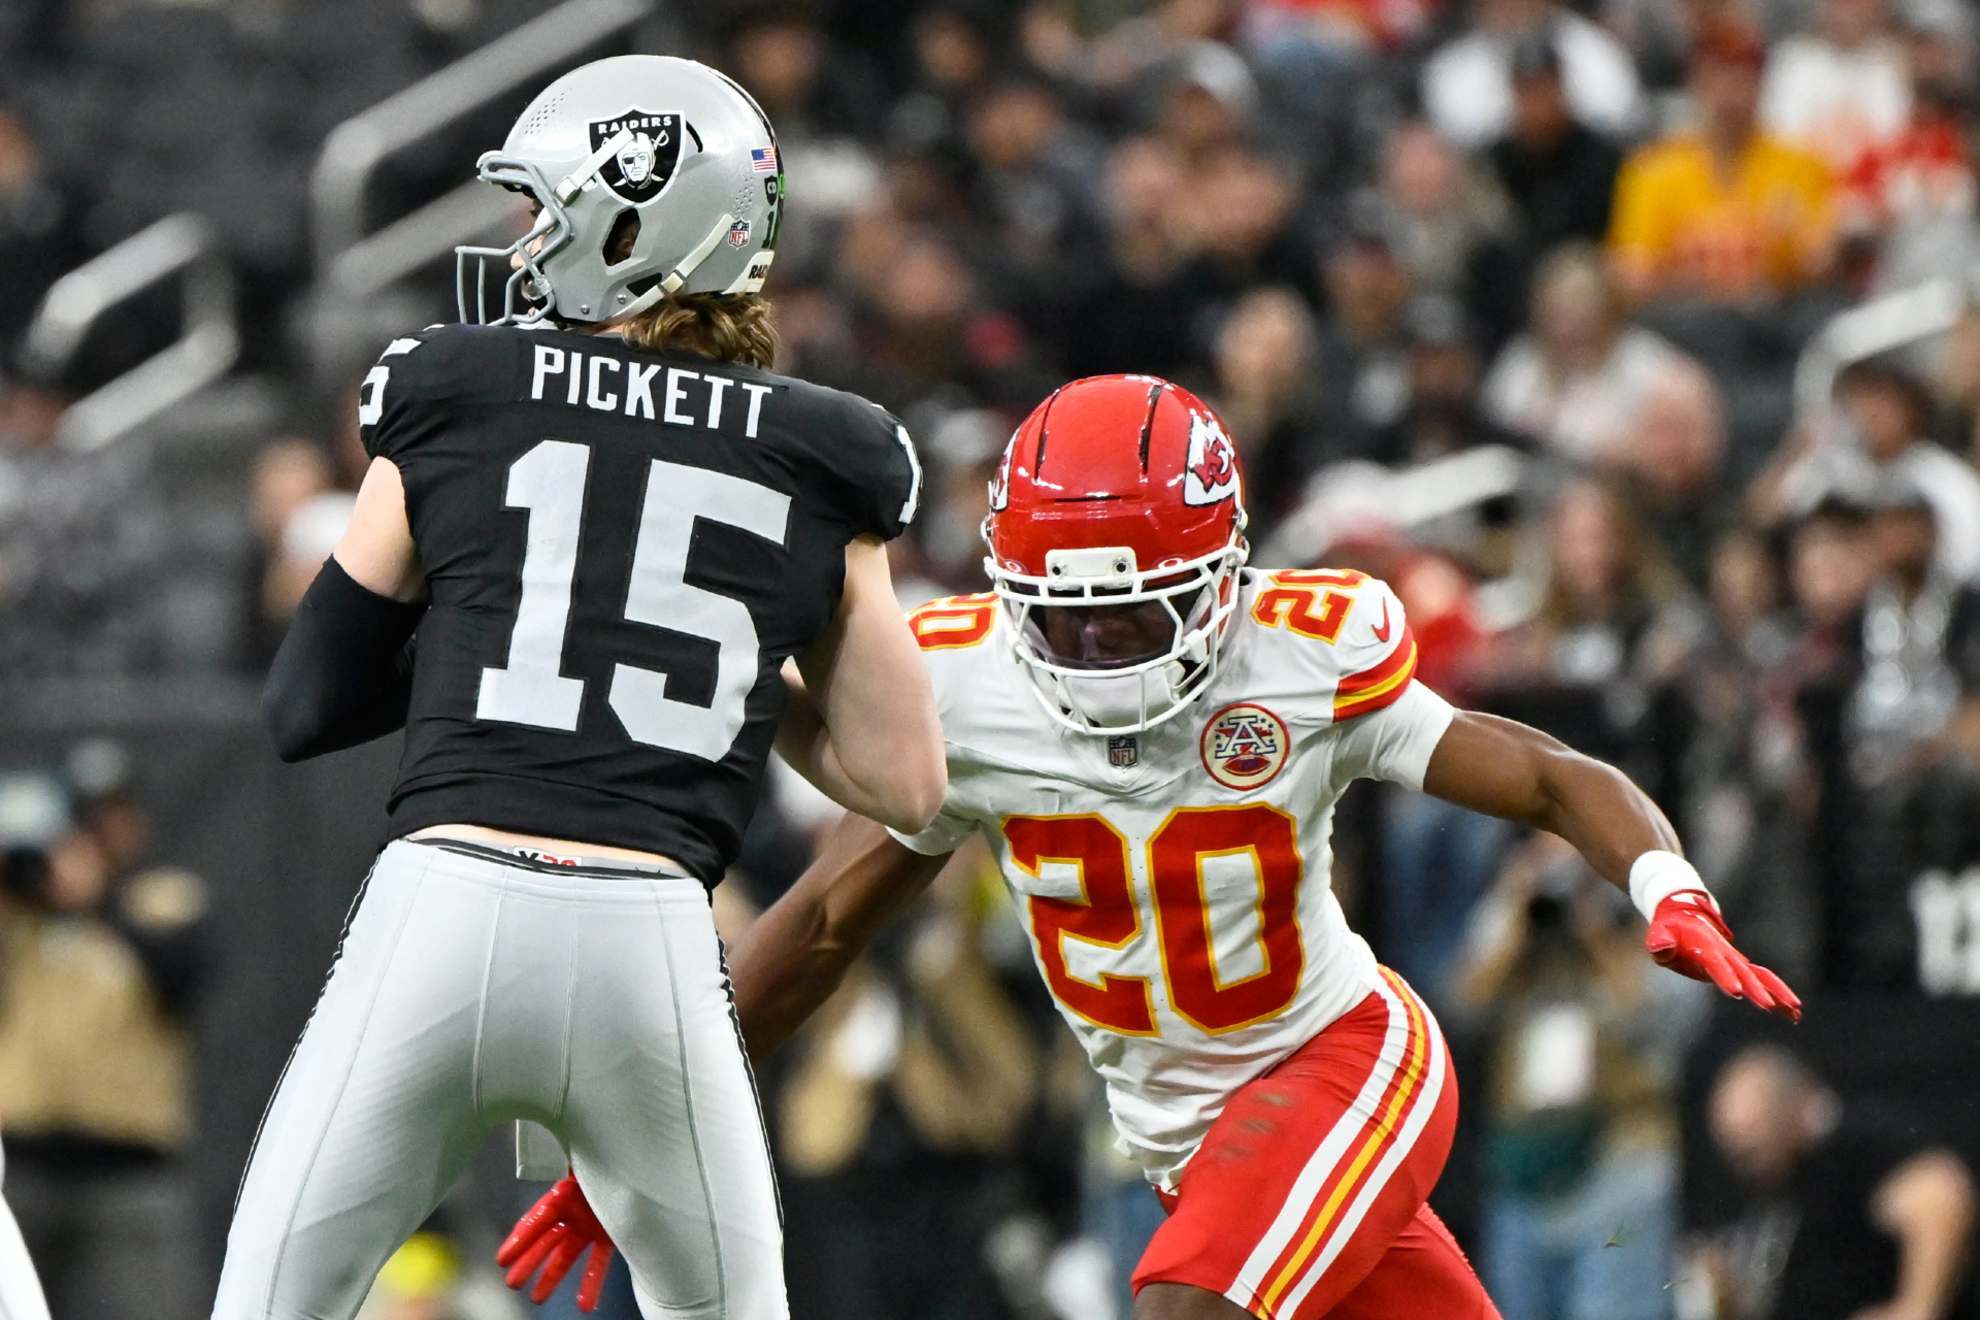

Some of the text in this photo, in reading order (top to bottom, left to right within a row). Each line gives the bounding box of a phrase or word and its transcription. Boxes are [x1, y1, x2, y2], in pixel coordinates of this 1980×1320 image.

[598, 116, 672, 134] RAIDERS
[531, 344, 773, 438] PICKETT
[476, 440, 793, 763] 15
[1110, 748, 1137, 764] NFL
[1215, 714, 1278, 760] A
[1001, 800, 1307, 1038] 20
